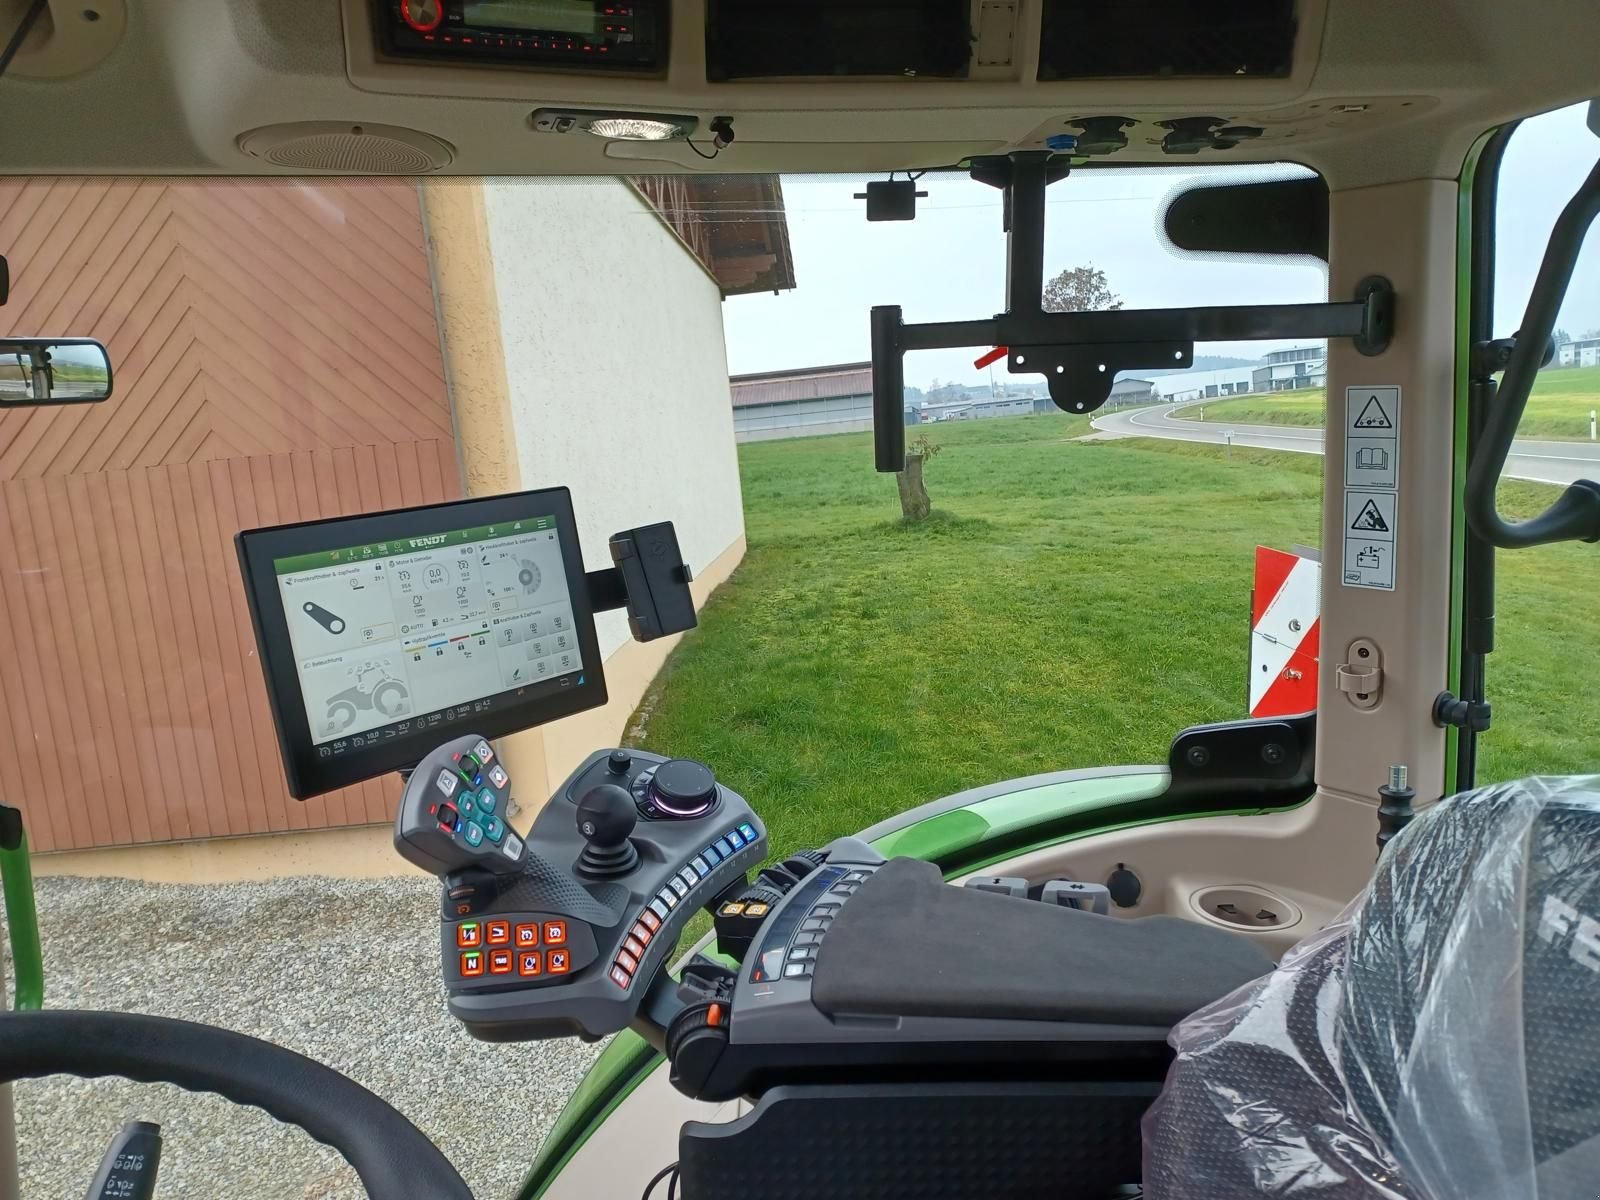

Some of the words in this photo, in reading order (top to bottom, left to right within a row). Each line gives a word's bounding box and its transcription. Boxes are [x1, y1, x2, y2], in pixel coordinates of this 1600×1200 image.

[409, 534, 447, 547] FENDT
[429, 569, 441, 578] 0,0
[468, 959, 477, 969] N
